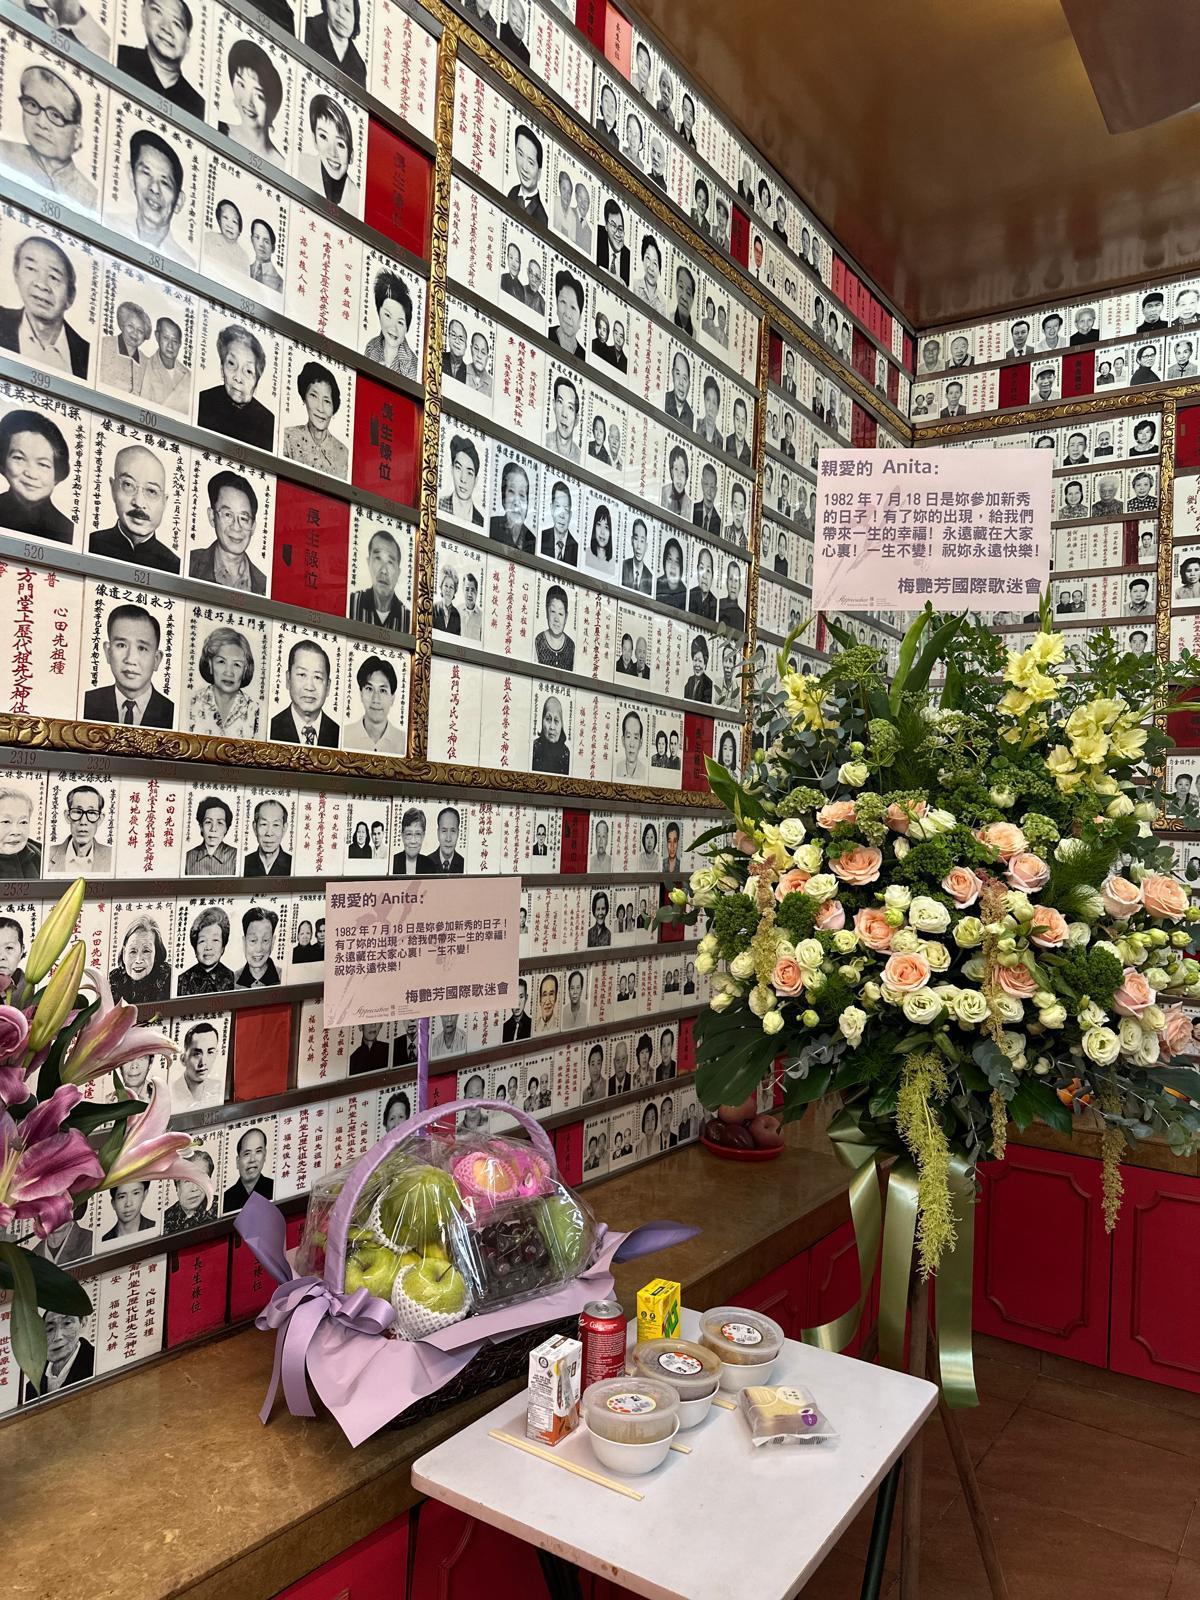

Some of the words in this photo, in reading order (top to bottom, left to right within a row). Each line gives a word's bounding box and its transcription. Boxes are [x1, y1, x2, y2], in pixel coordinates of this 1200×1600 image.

[50, 30, 70, 50] 350
[157, 98, 173, 115] 351
[247, 153, 262, 170] 352
[41, 201, 61, 219] 380
[150, 253, 165, 271] 381
[240, 297, 255, 315] 382
[31, 371, 51, 388] 399
[139, 410, 157, 428] 500
[821, 460, 873, 477] 親愛的
[882, 459, 940, 475] Anita:
[824, 493, 853, 506] 1982
[858, 492, 872, 506] 年
[876, 493, 883, 505] 7
[888, 492, 901, 506] 月
[907, 493, 921, 506] 18
[926, 492, 1030, 507] 日是妳參加新秀
[823, 509, 1034, 524] 的日子！有了妳的出現，給我們
[822, 526, 934, 541] 帶來一生的幸福!
[942, 526, 1033, 541] 永遠藏在大家
[24, 543, 44, 560] 520
[867, 543, 933, 558] 一生不變!
[942, 543, 1040, 558] 祝妳永遠快樂!
[44, 572, 60, 588] 普
[134, 570, 151, 585] 521
[95, 584, 175, 611] 方永創之遺像
[9, 567, 37, 715] 方門堂上歷代祖先之神位
[49, 607, 68, 675] 心田先祖種
[447, 665, 461, 759] 藍門馮氏之神位
[10, 751, 37, 765] 2319
[87, 757, 111, 770] 2320
[163, 793, 176, 847] 心田先祖種
[3, 883, 30, 896] 2532
[330, 893, 377, 909] 親愛的
[381, 892, 424, 905] Anita:
[335, 927, 357, 937] 1982
[359, 925, 369, 936] 年
[372, 925, 377, 935] 7
[380, 924, 389, 935] 月
[393, 924, 403, 934] 18
[406, 918, 507, 934] 日是妳參加新秀的日子！
[90, 930, 103, 969] 心田先祖
[428, 945, 470, 956] 一生不變!
[334, 962, 401, 976] 祝妳永遠快樂!
[336, 1106, 344, 1114] 山
[296, 1109, 309, 1190] 陳門堂上歷代祖先之神位
[313, 1126, 324, 1169] 心田先祖種
[110, 1275, 122, 1285] 安
[143, 1288, 157, 1338] 心田先祖種
[106, 1299, 120, 1351] 福地後人耕
